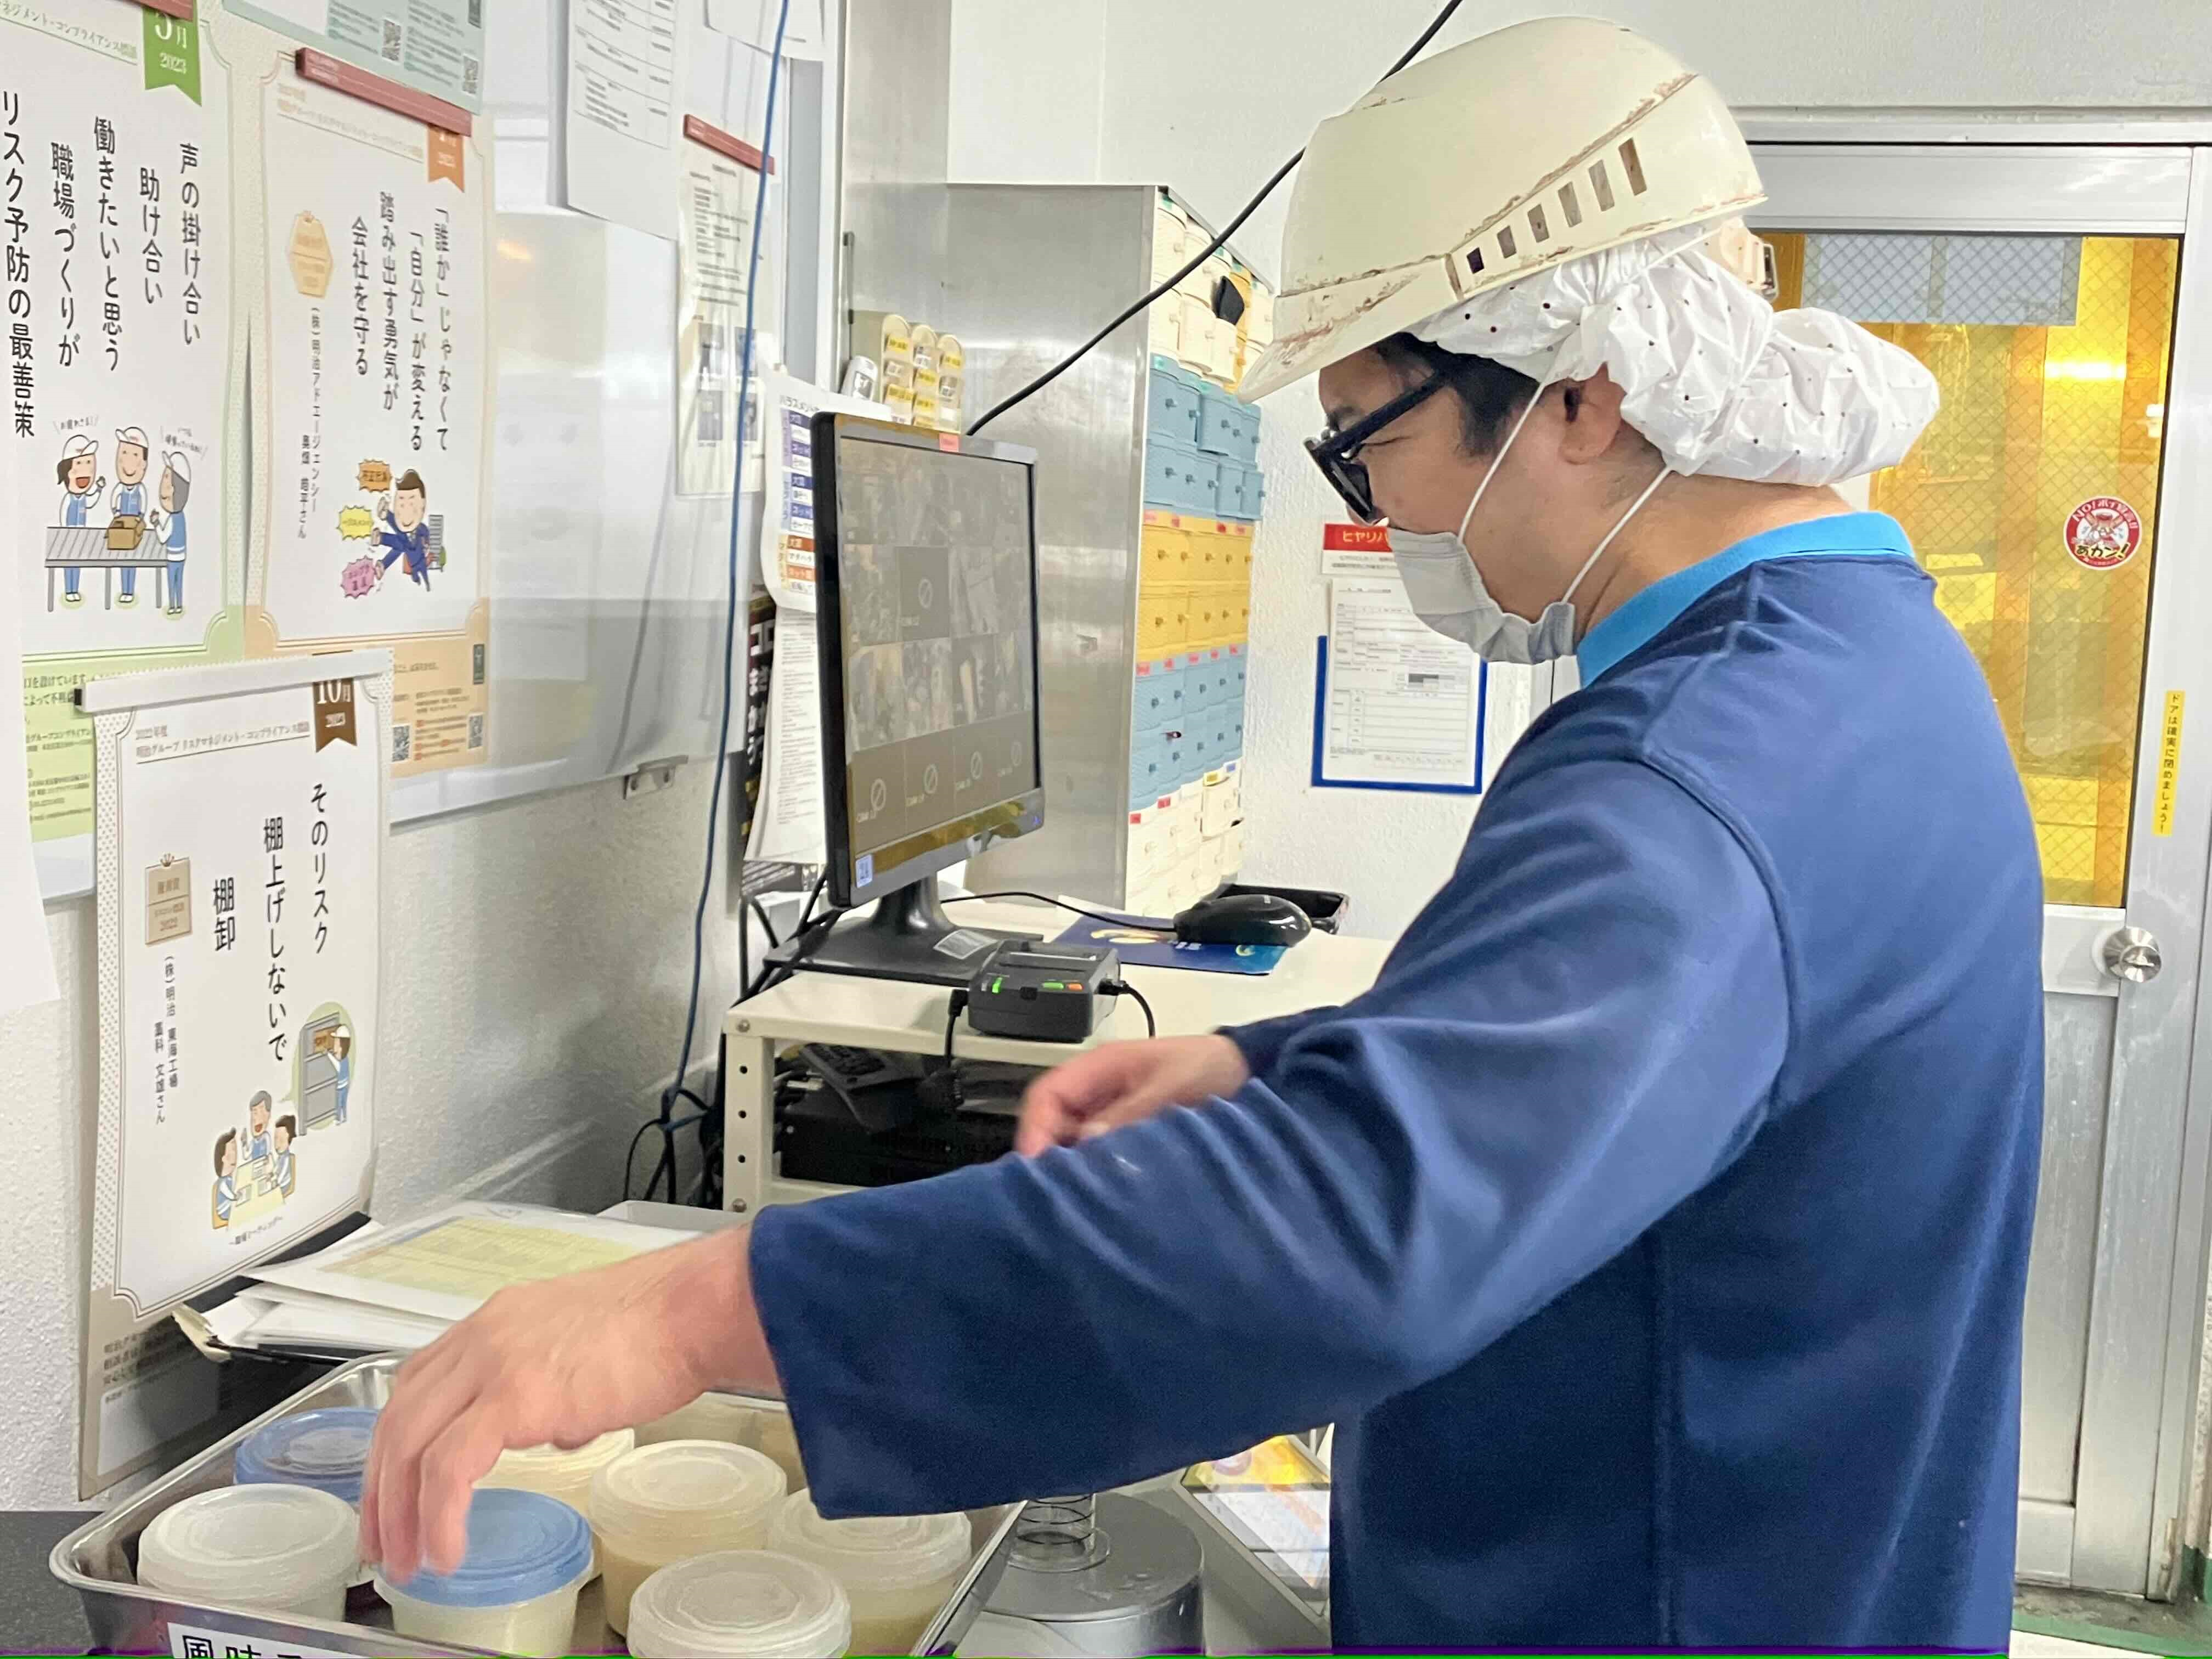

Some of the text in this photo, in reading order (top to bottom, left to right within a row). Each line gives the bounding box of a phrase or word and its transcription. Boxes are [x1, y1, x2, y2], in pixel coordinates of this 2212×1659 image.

[3, 91, 35, 438] リスク予防の最善策
[51, 142, 80, 366] 職場づくりが
[94, 116, 122, 371] 働きたいと思う
[140, 168, 163, 304] 助け合い
[180, 142, 201, 345] 声の掛け合い
[351, 216, 370, 375] 会社を守る
[380, 191, 399, 410] 踏み出す勇気が
[409, 232, 426, 450] 「自分」が変える
[435, 208, 452, 450] 「誰か」じゃなくて
[213, 877, 236, 951] 棚卸
[263, 816, 287, 1062] 棚上げしないで
[311, 783, 329, 954] そのリスク
